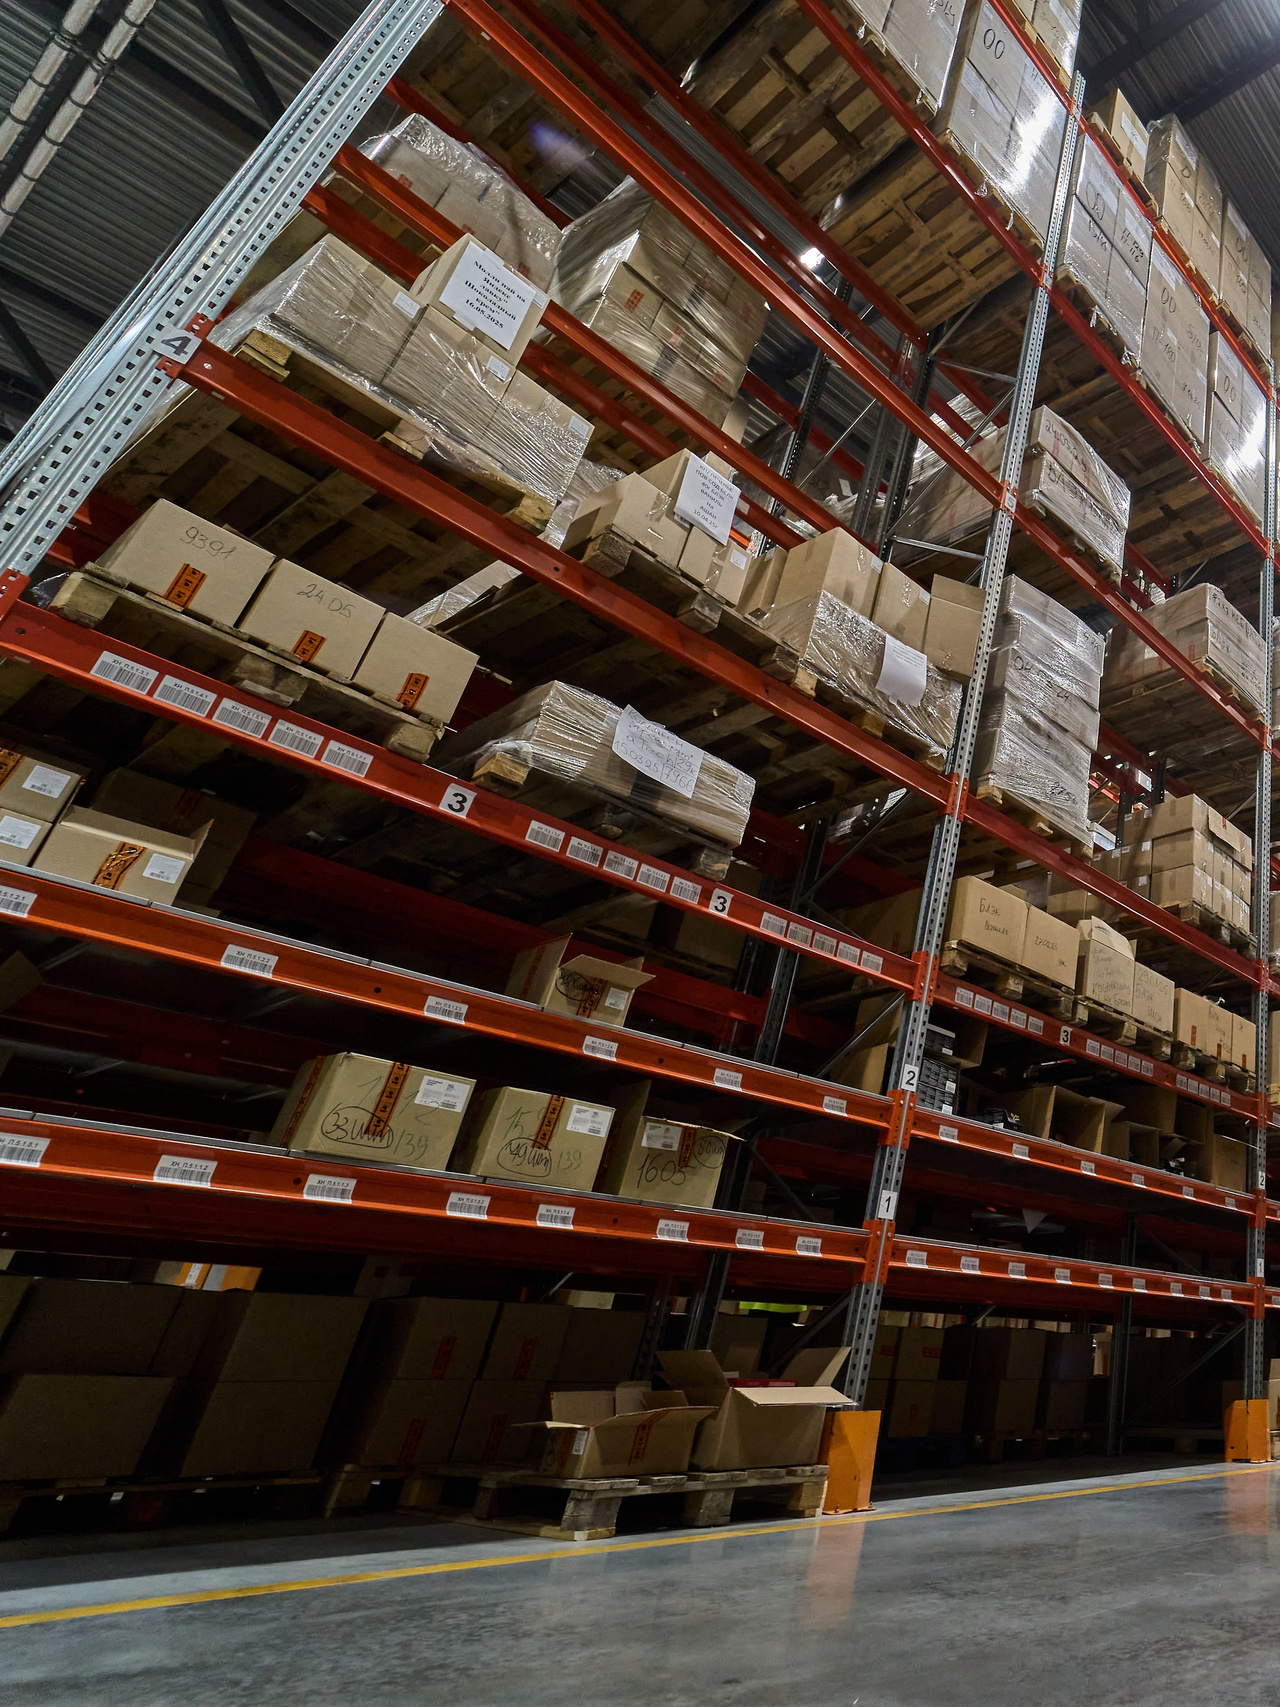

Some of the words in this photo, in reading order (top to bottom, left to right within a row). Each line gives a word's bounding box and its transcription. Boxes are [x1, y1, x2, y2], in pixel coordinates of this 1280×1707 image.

[465, 299, 504, 329] 16.05.2025
[161, 334, 191, 357] 4
[122, 662, 150, 678] П.5.1.3.1
[447, 791, 469, 814] 3
[0, 889, 26, 902] .5.1.2.1
[713, 894, 728, 914] 3
[1062, 1030, 1070, 1043] 3
[905, 1070, 916, 1087] 2
[1258, 1175, 1265, 1186] 2
[882, 1195, 892, 1213] 1
